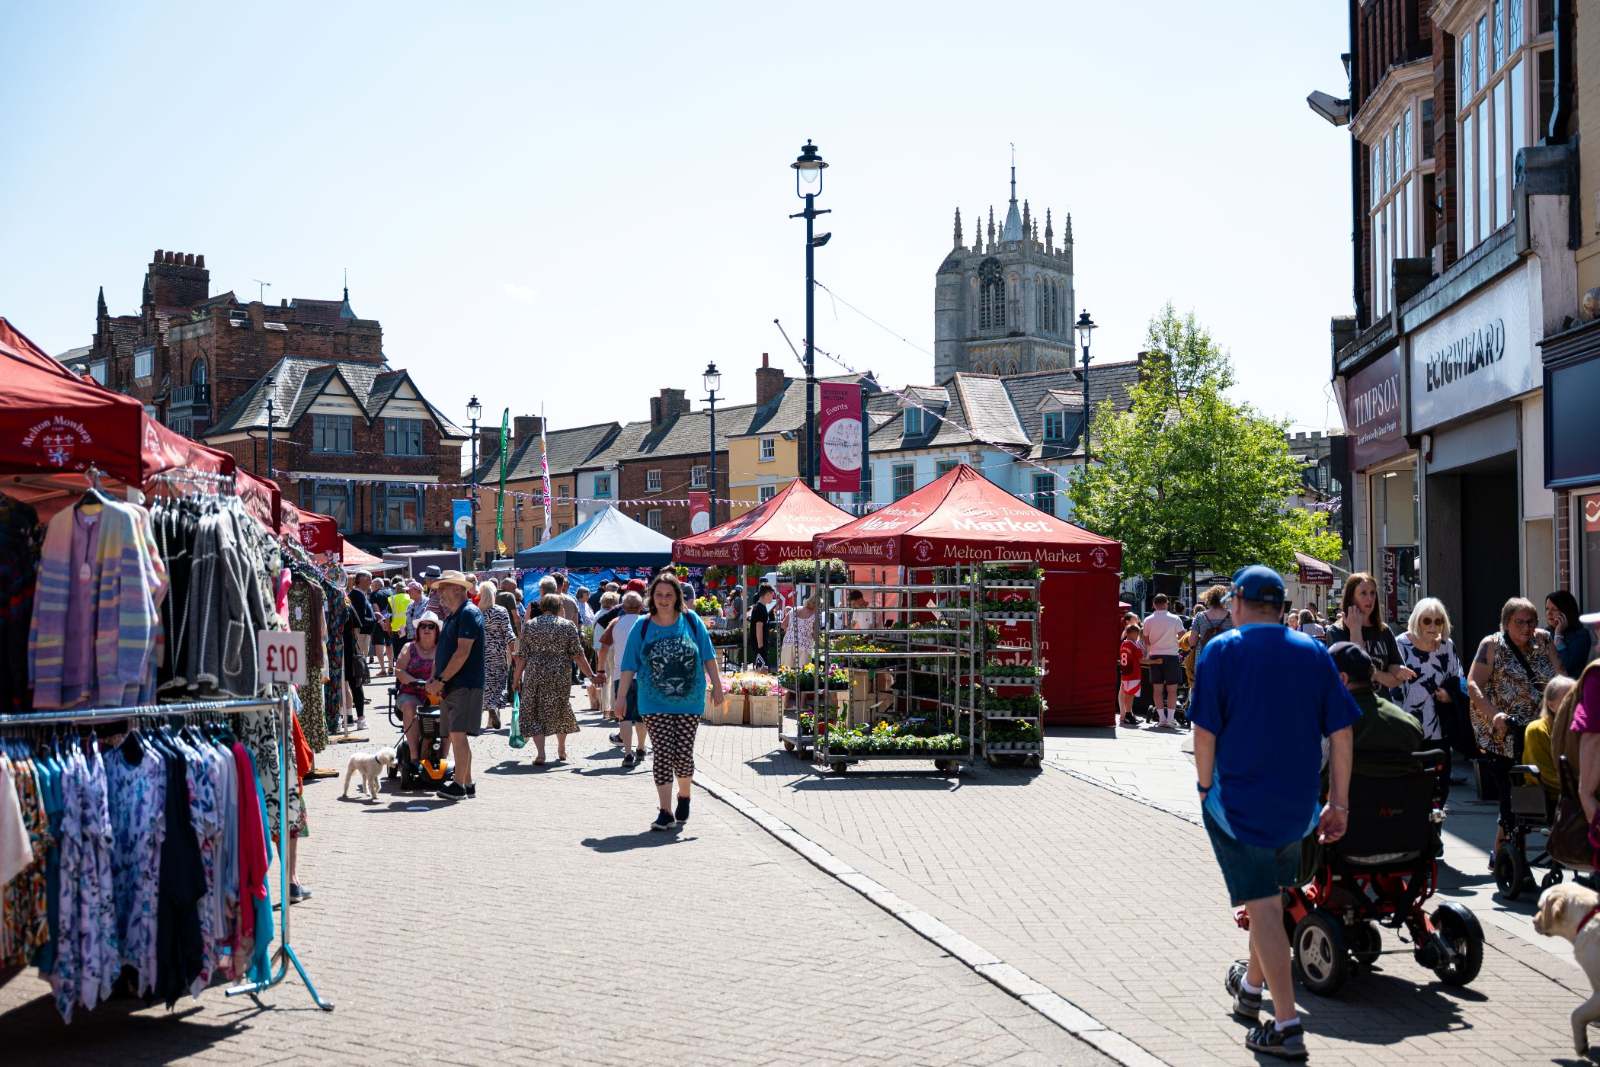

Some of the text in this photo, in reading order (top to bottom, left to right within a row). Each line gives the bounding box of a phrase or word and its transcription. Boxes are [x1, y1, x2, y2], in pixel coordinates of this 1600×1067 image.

[1426, 318, 1505, 393] ECIGWIZARD
[825, 403, 849, 416] Events
[1354, 373, 1398, 428] TIMPSON
[22, 419, 53, 448] Melton
[950, 516, 1054, 533] Market
[779, 547, 812, 558] Melto
[943, 544, 992, 560] Melton
[994, 545, 1032, 561] Town
[1034, 548, 1081, 563] Market
[1016, 637, 1049, 650] Ton
[266, 644, 298, 672] £10
